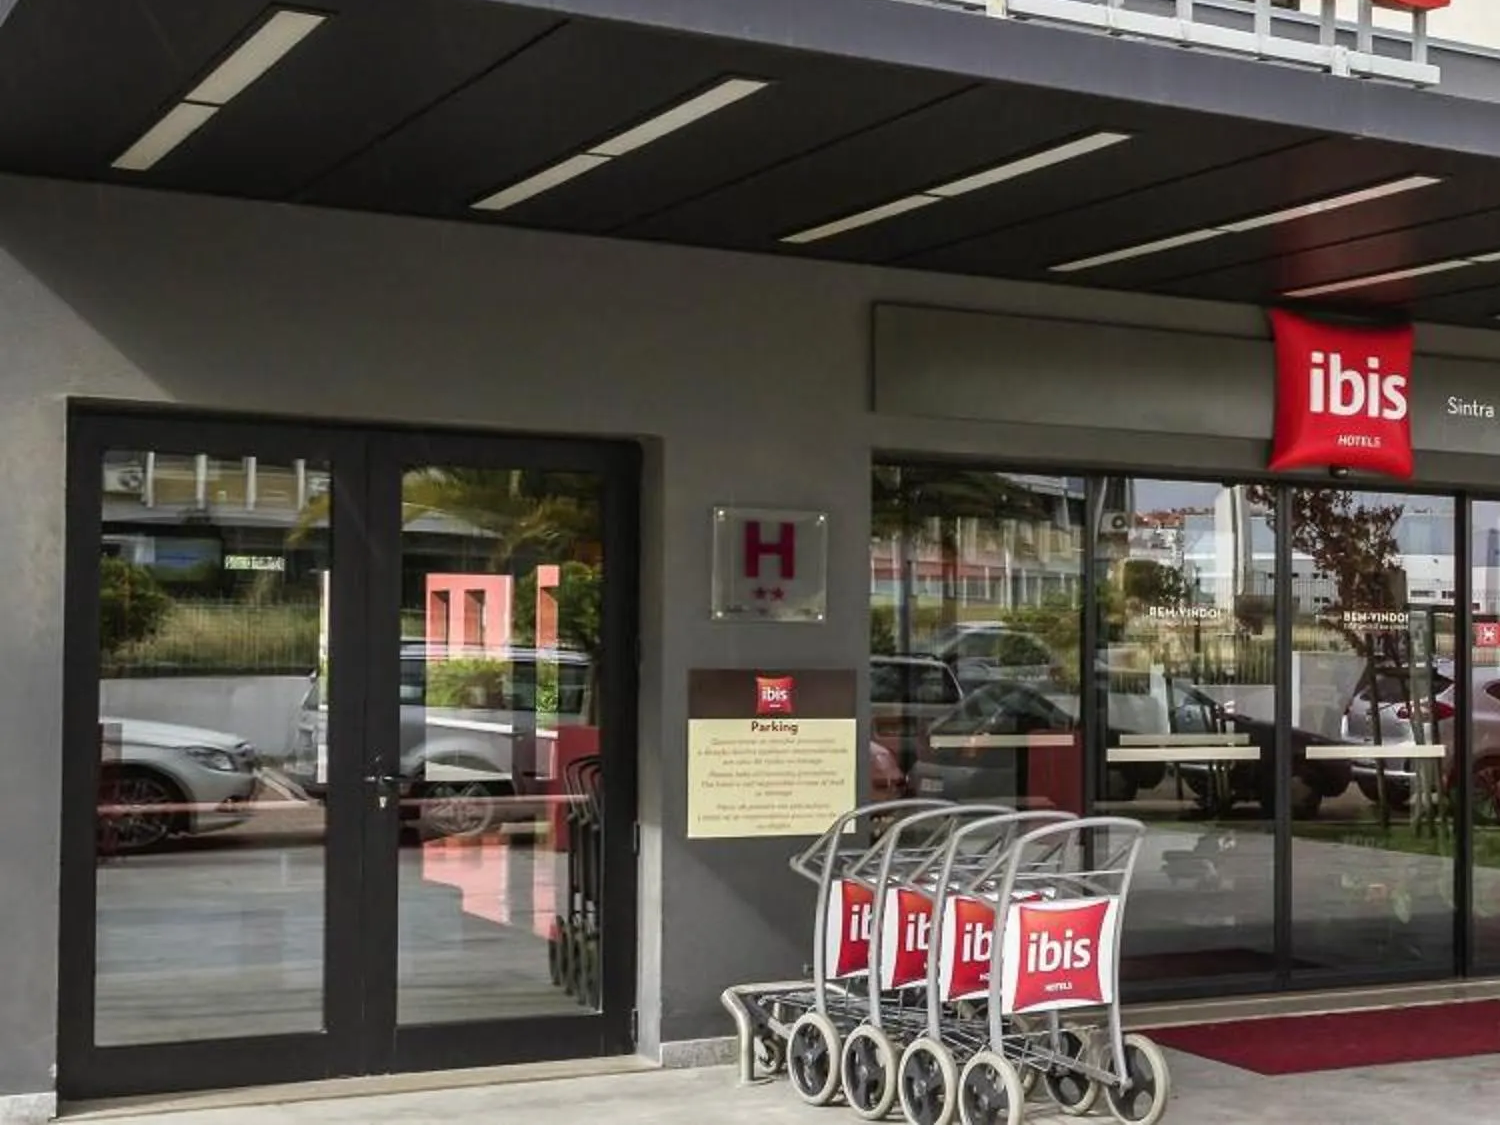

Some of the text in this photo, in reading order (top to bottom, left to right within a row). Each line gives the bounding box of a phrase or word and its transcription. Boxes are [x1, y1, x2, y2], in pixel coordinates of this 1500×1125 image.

[1309, 351, 1408, 420] ibis
[1447, 395, 1496, 418] Sintra
[1337, 434, 1382, 448] HOTELS
[744, 520, 796, 580] H
[761, 686, 788, 702] ibis
[751, 720, 799, 736] Parking
[1027, 929, 1091, 974] ibis
